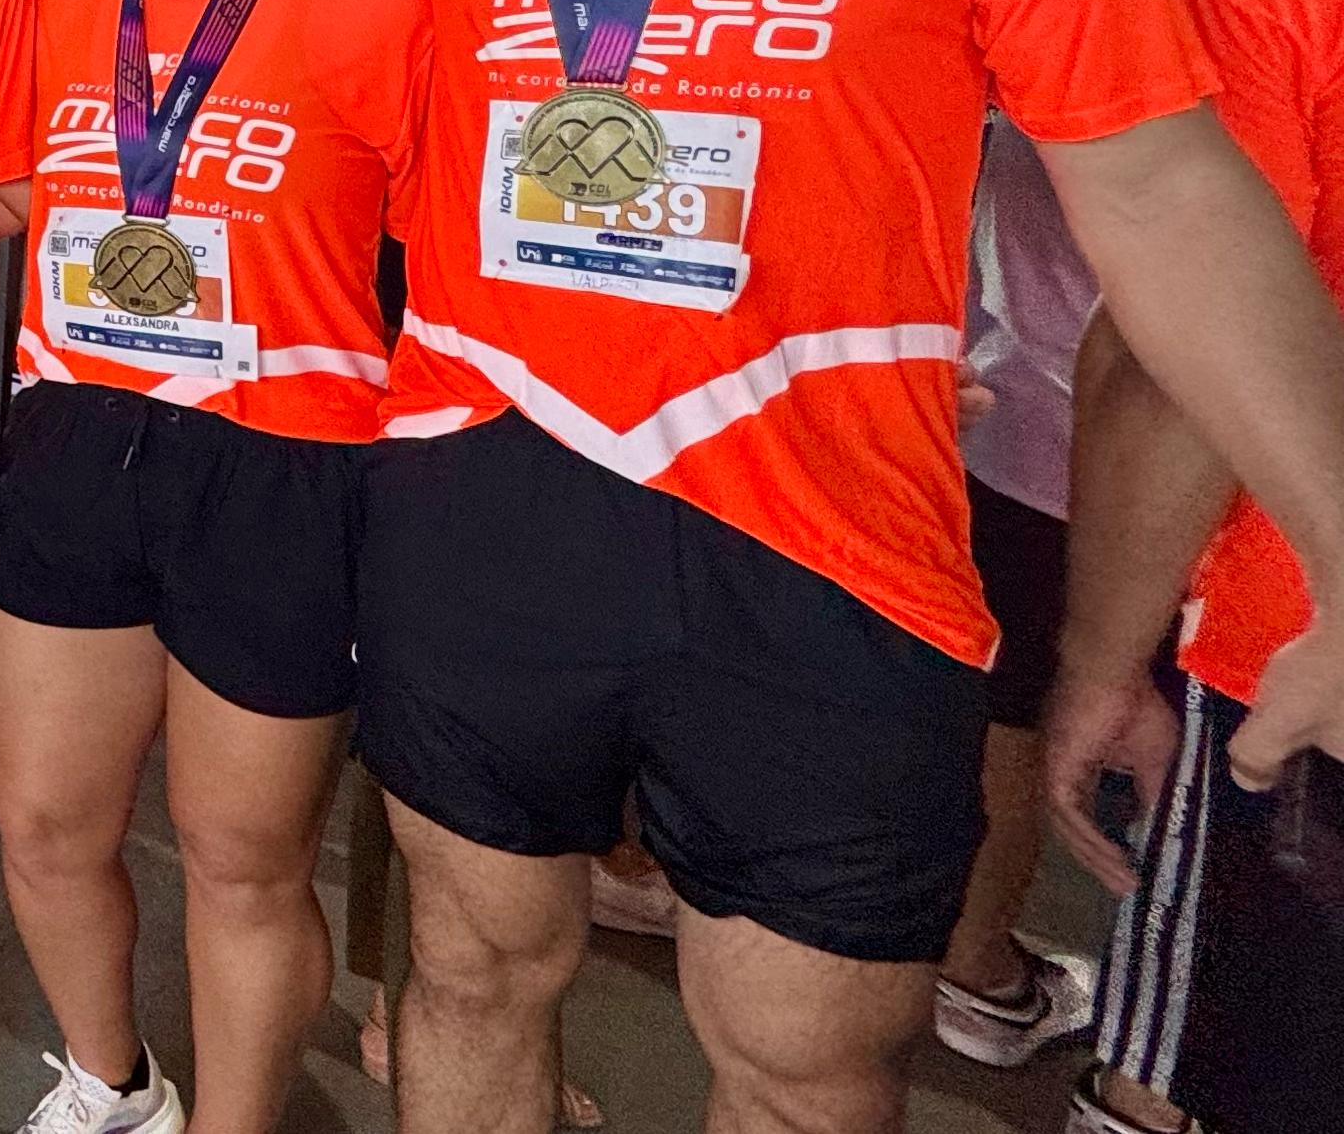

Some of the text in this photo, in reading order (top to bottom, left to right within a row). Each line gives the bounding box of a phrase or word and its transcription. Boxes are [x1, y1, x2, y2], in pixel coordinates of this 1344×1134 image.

[632, 77, 662, 94] de
[678, 79, 813, 101] Rondônia
[499, 166, 515, 214] 10KM
[52, 260, 60, 300] 10KM
[103, 312, 180, 333] ALEXSANDRA
